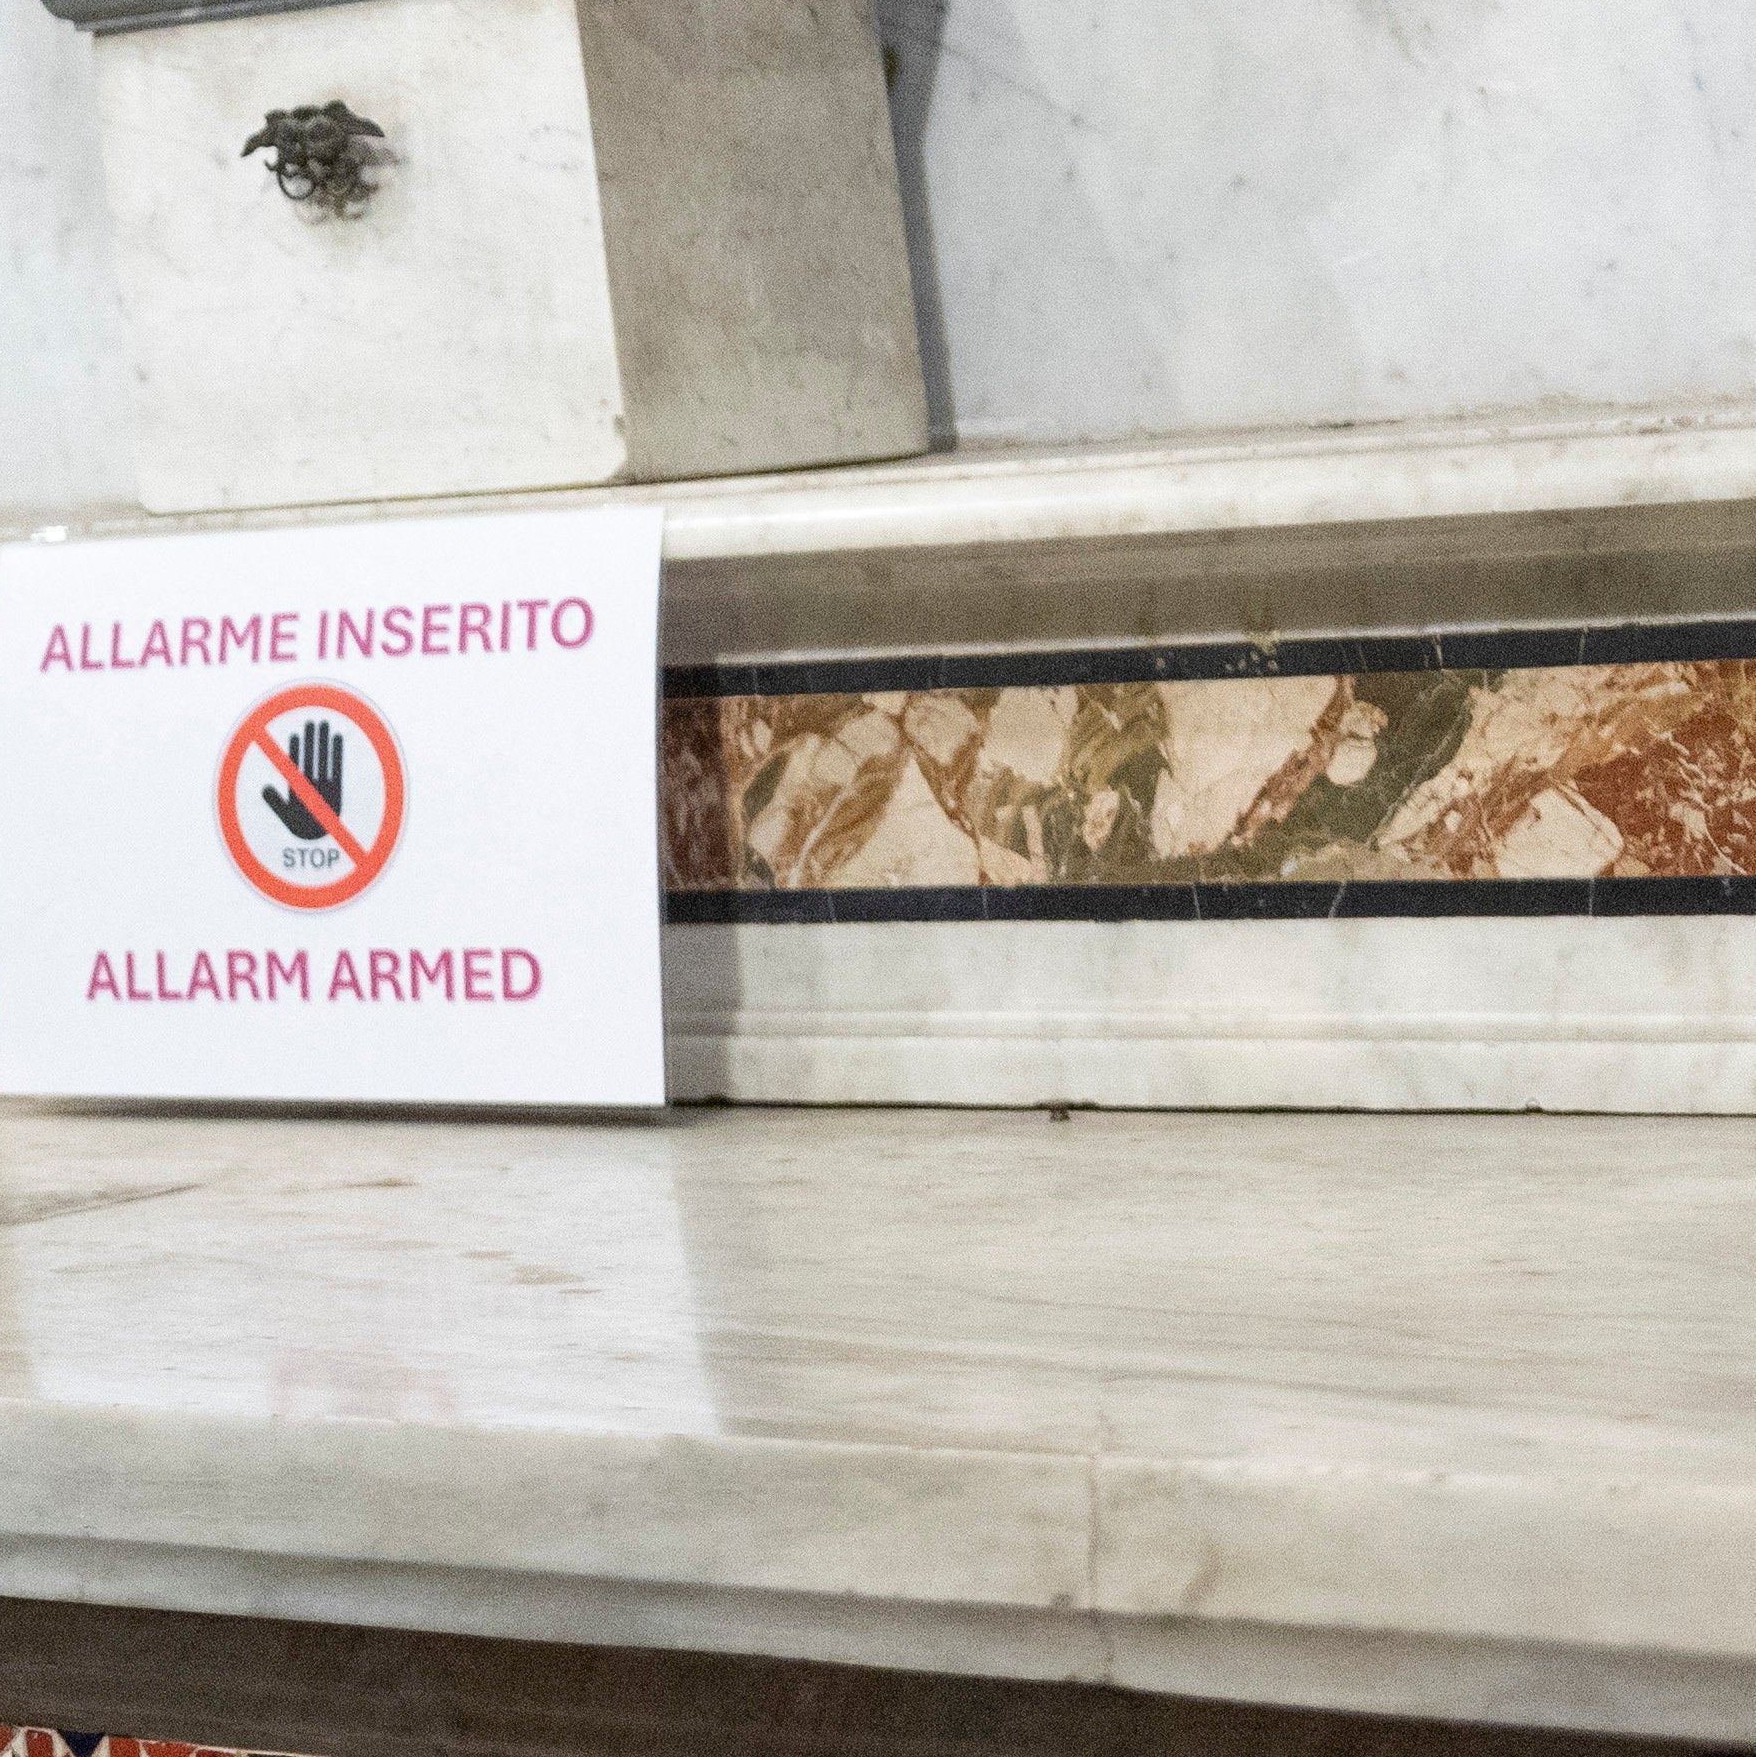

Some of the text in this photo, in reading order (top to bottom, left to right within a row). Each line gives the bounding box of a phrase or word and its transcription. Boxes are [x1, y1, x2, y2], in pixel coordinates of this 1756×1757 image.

[40, 596, 597, 673] ALLARME INSERITO
[283, 848, 339, 868] STOP
[86, 947, 543, 1003] ALLARM ARMED
